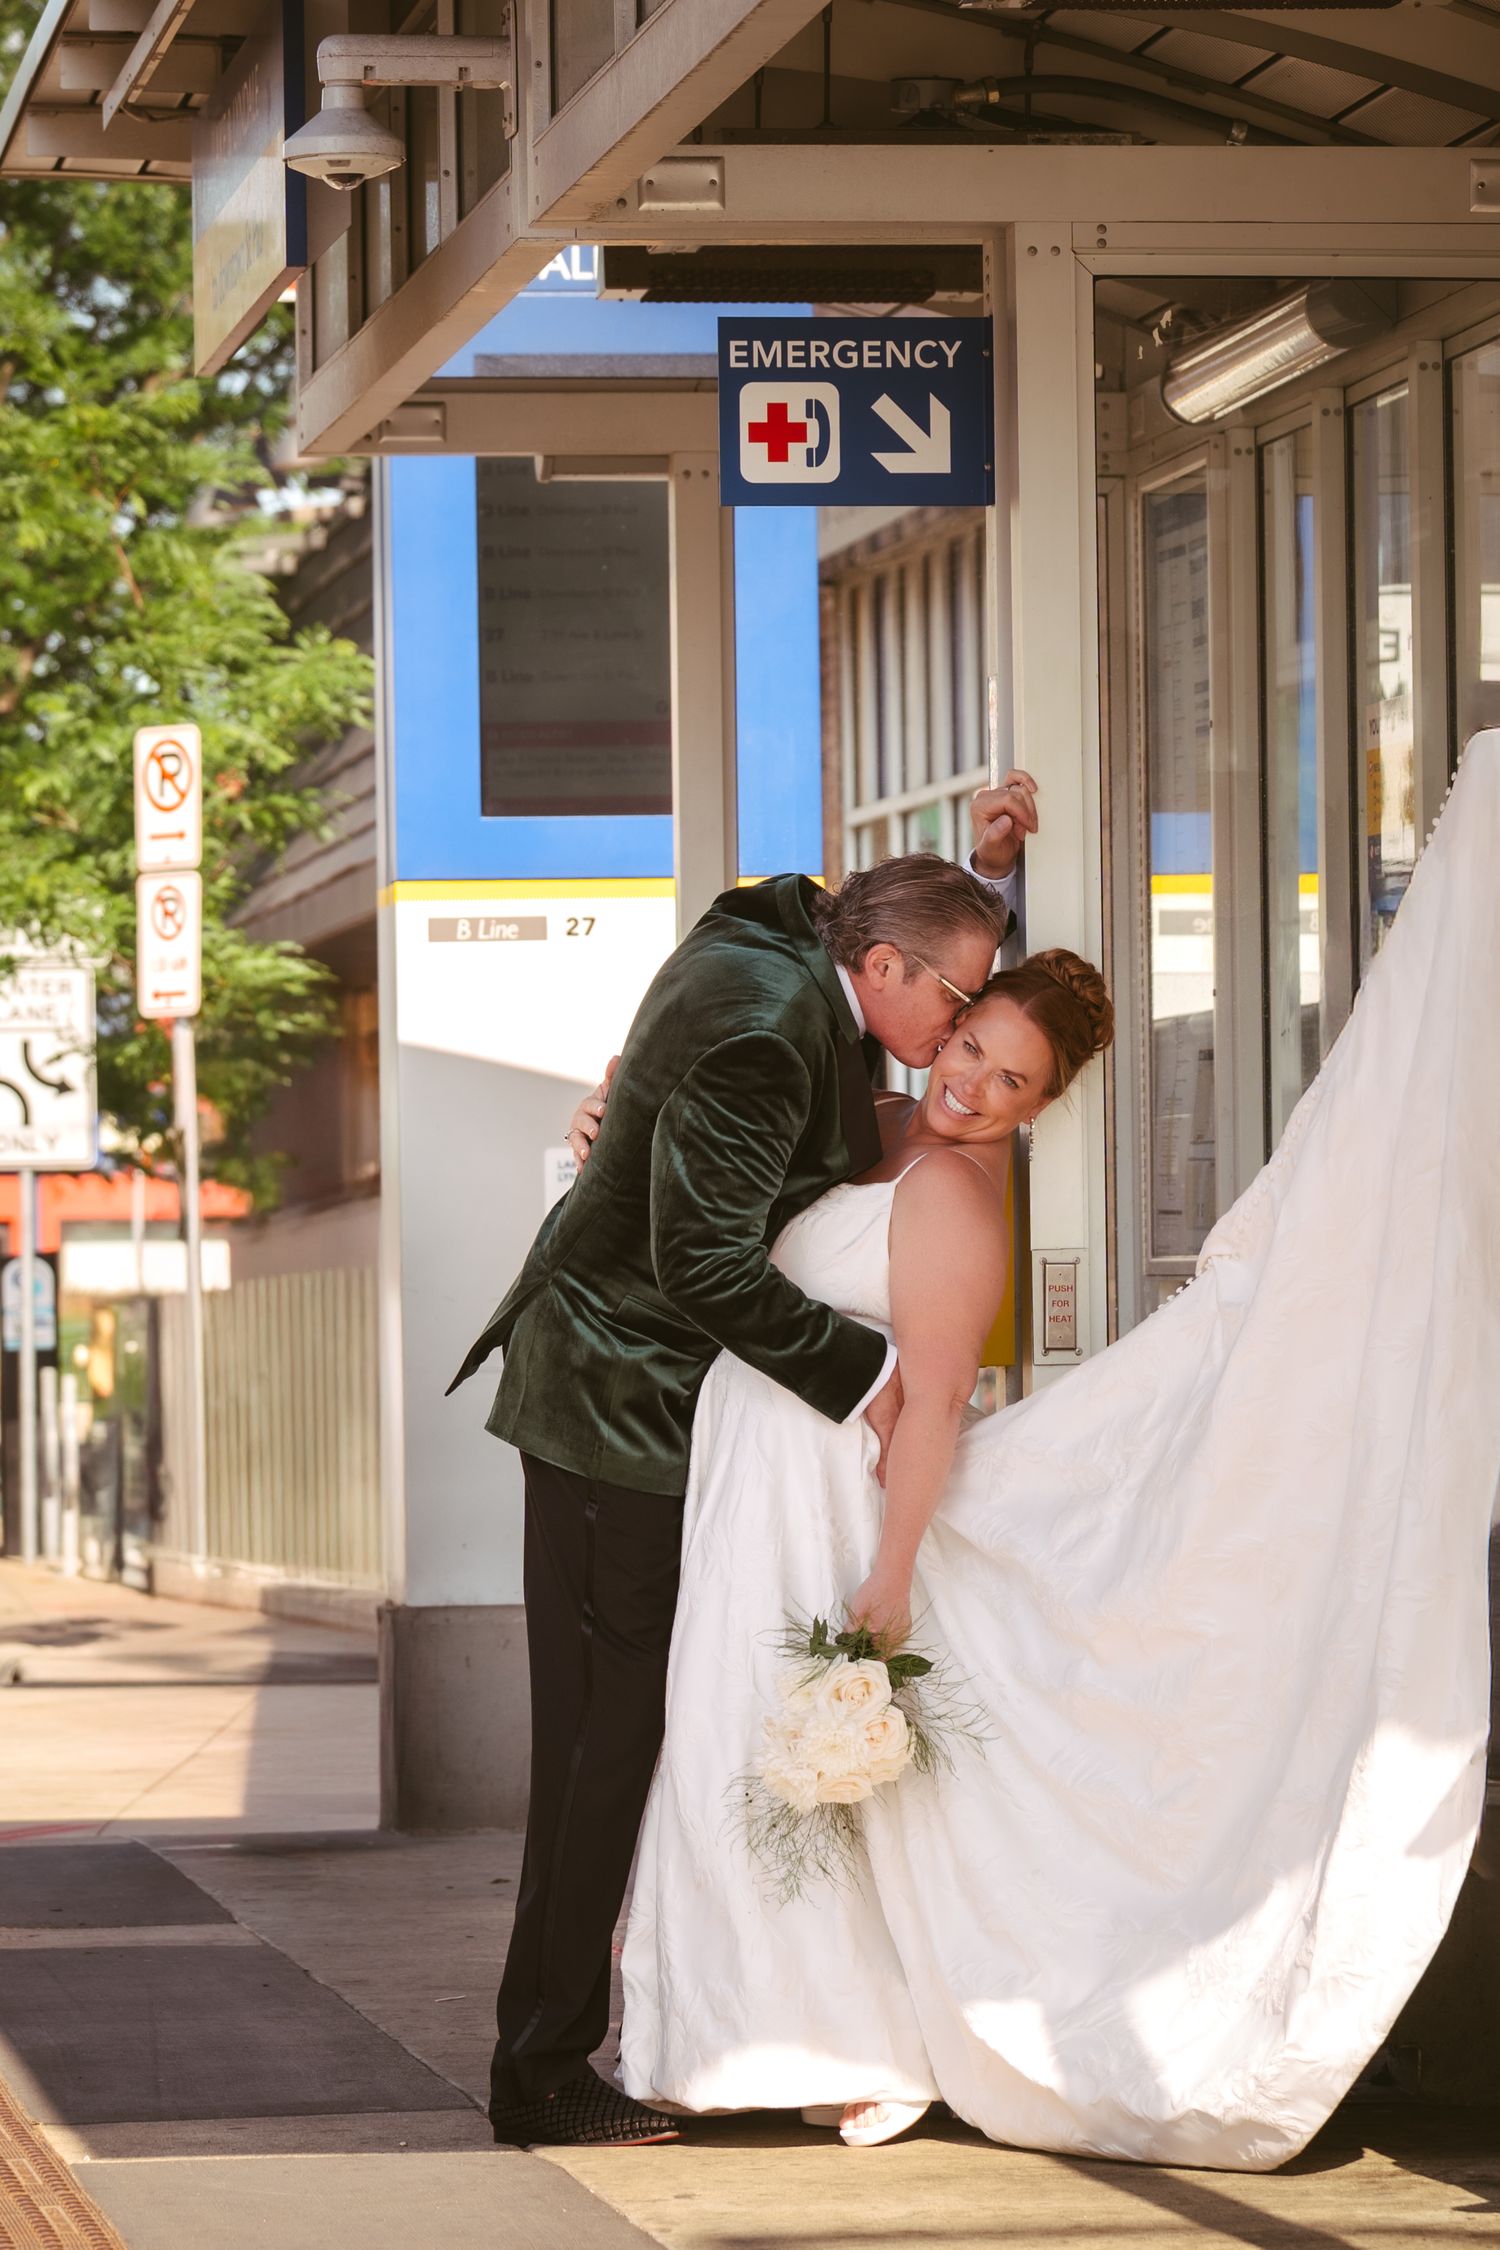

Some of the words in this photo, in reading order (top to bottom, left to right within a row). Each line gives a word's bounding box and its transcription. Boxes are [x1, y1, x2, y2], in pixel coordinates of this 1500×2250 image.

[729, 339, 963, 369] EMERGENCY
[456, 918, 472, 940] B
[478, 918, 520, 940] Line
[566, 917, 596, 936] 27
[1, 978, 72, 996] NTER
[1048, 1285, 1074, 1293] PUSH
[1051, 1300, 1070, 1308] FOR
[1048, 1315, 1072, 1323] HEAT
